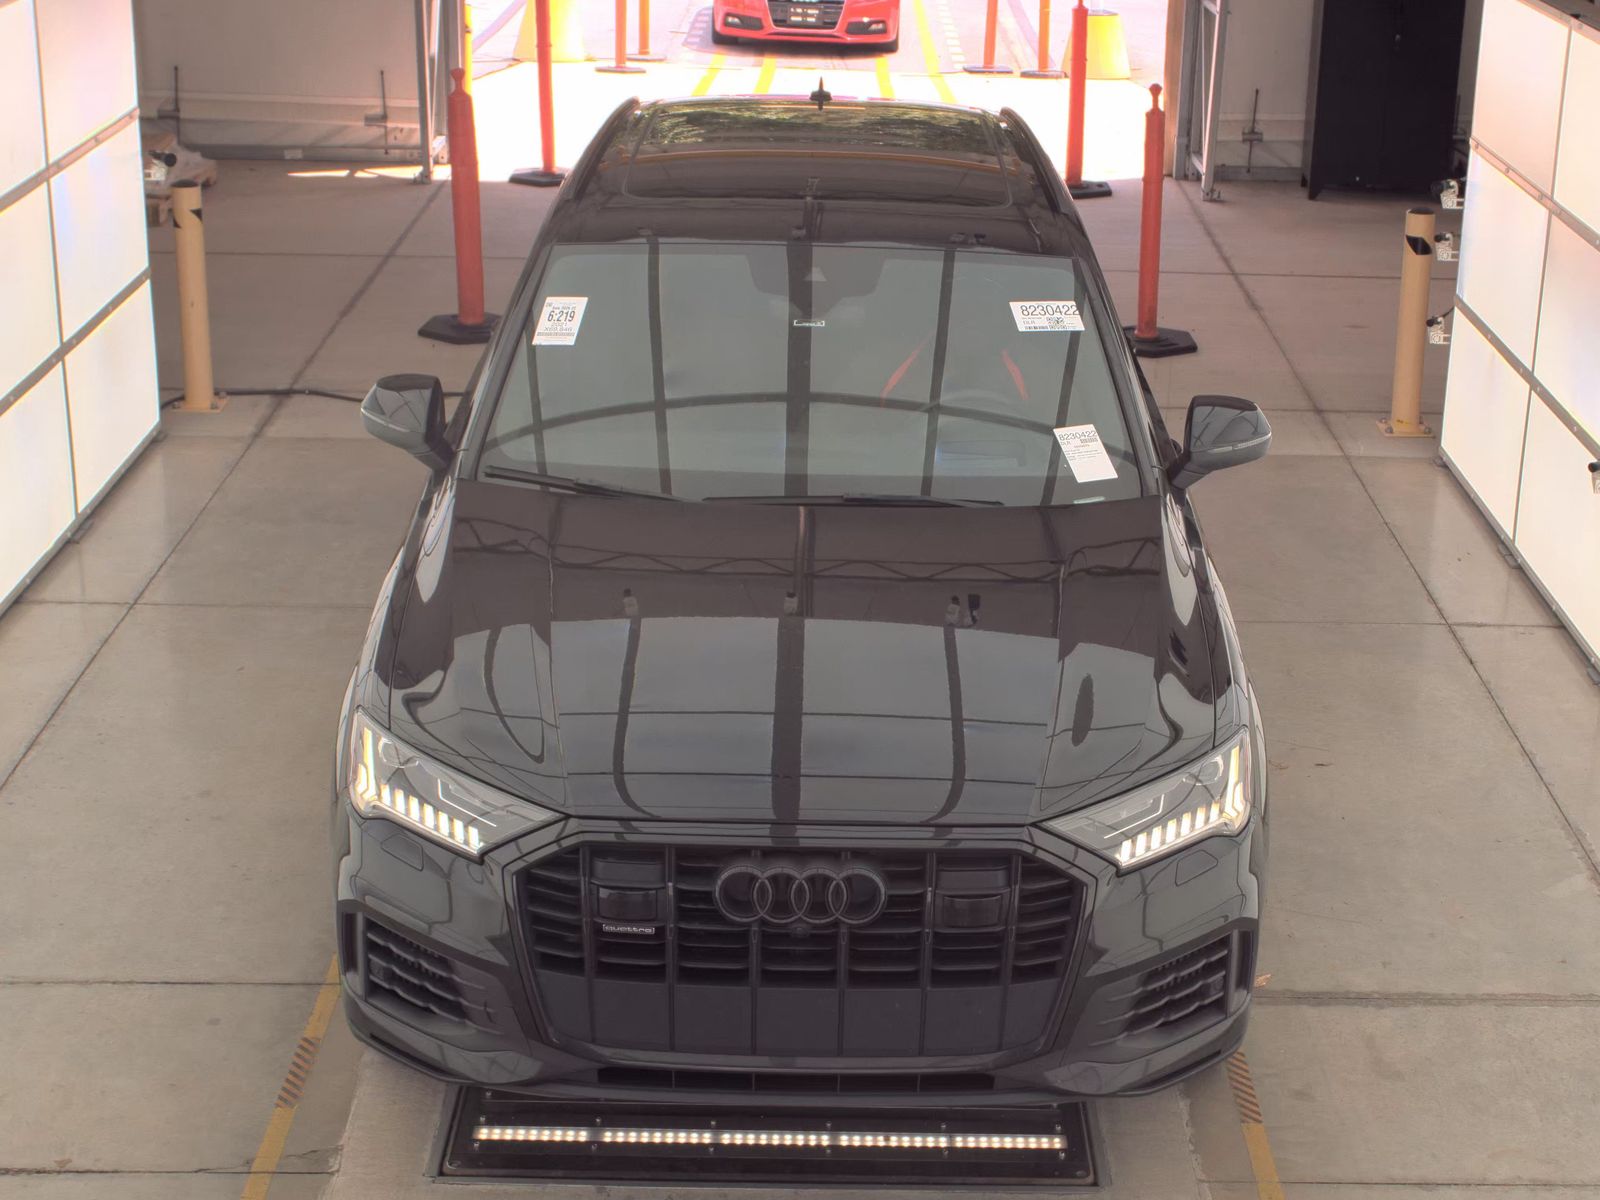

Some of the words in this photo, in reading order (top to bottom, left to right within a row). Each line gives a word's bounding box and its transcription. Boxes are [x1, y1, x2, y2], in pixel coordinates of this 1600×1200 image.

[547, 310, 576, 322] 6:219
[1020, 304, 1080, 317] 8230422
[1058, 430, 1098, 441] 8230422
[604, 925, 653, 934] quattro
